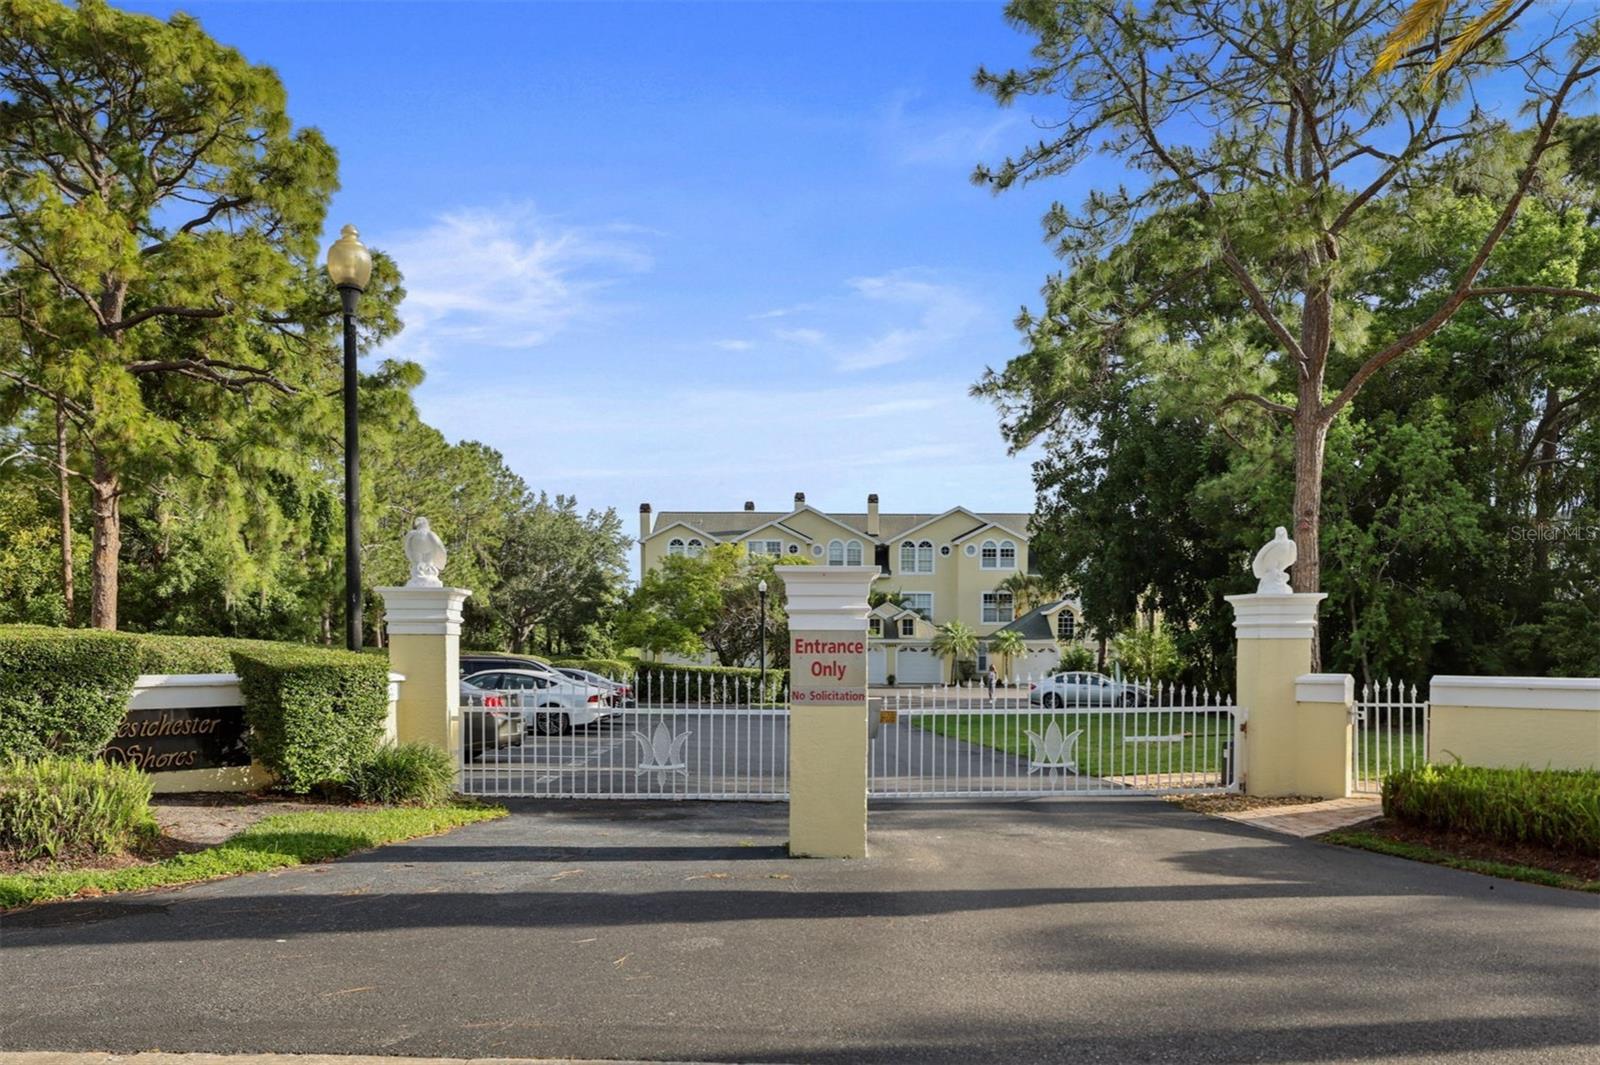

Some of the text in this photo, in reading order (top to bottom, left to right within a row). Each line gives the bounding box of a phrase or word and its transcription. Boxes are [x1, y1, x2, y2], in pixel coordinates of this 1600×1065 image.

[795, 639, 863, 653] Entrance
[811, 661, 846, 680] Only
[792, 690, 864, 700] No Solicitation
[112, 715, 221, 738] estchester
